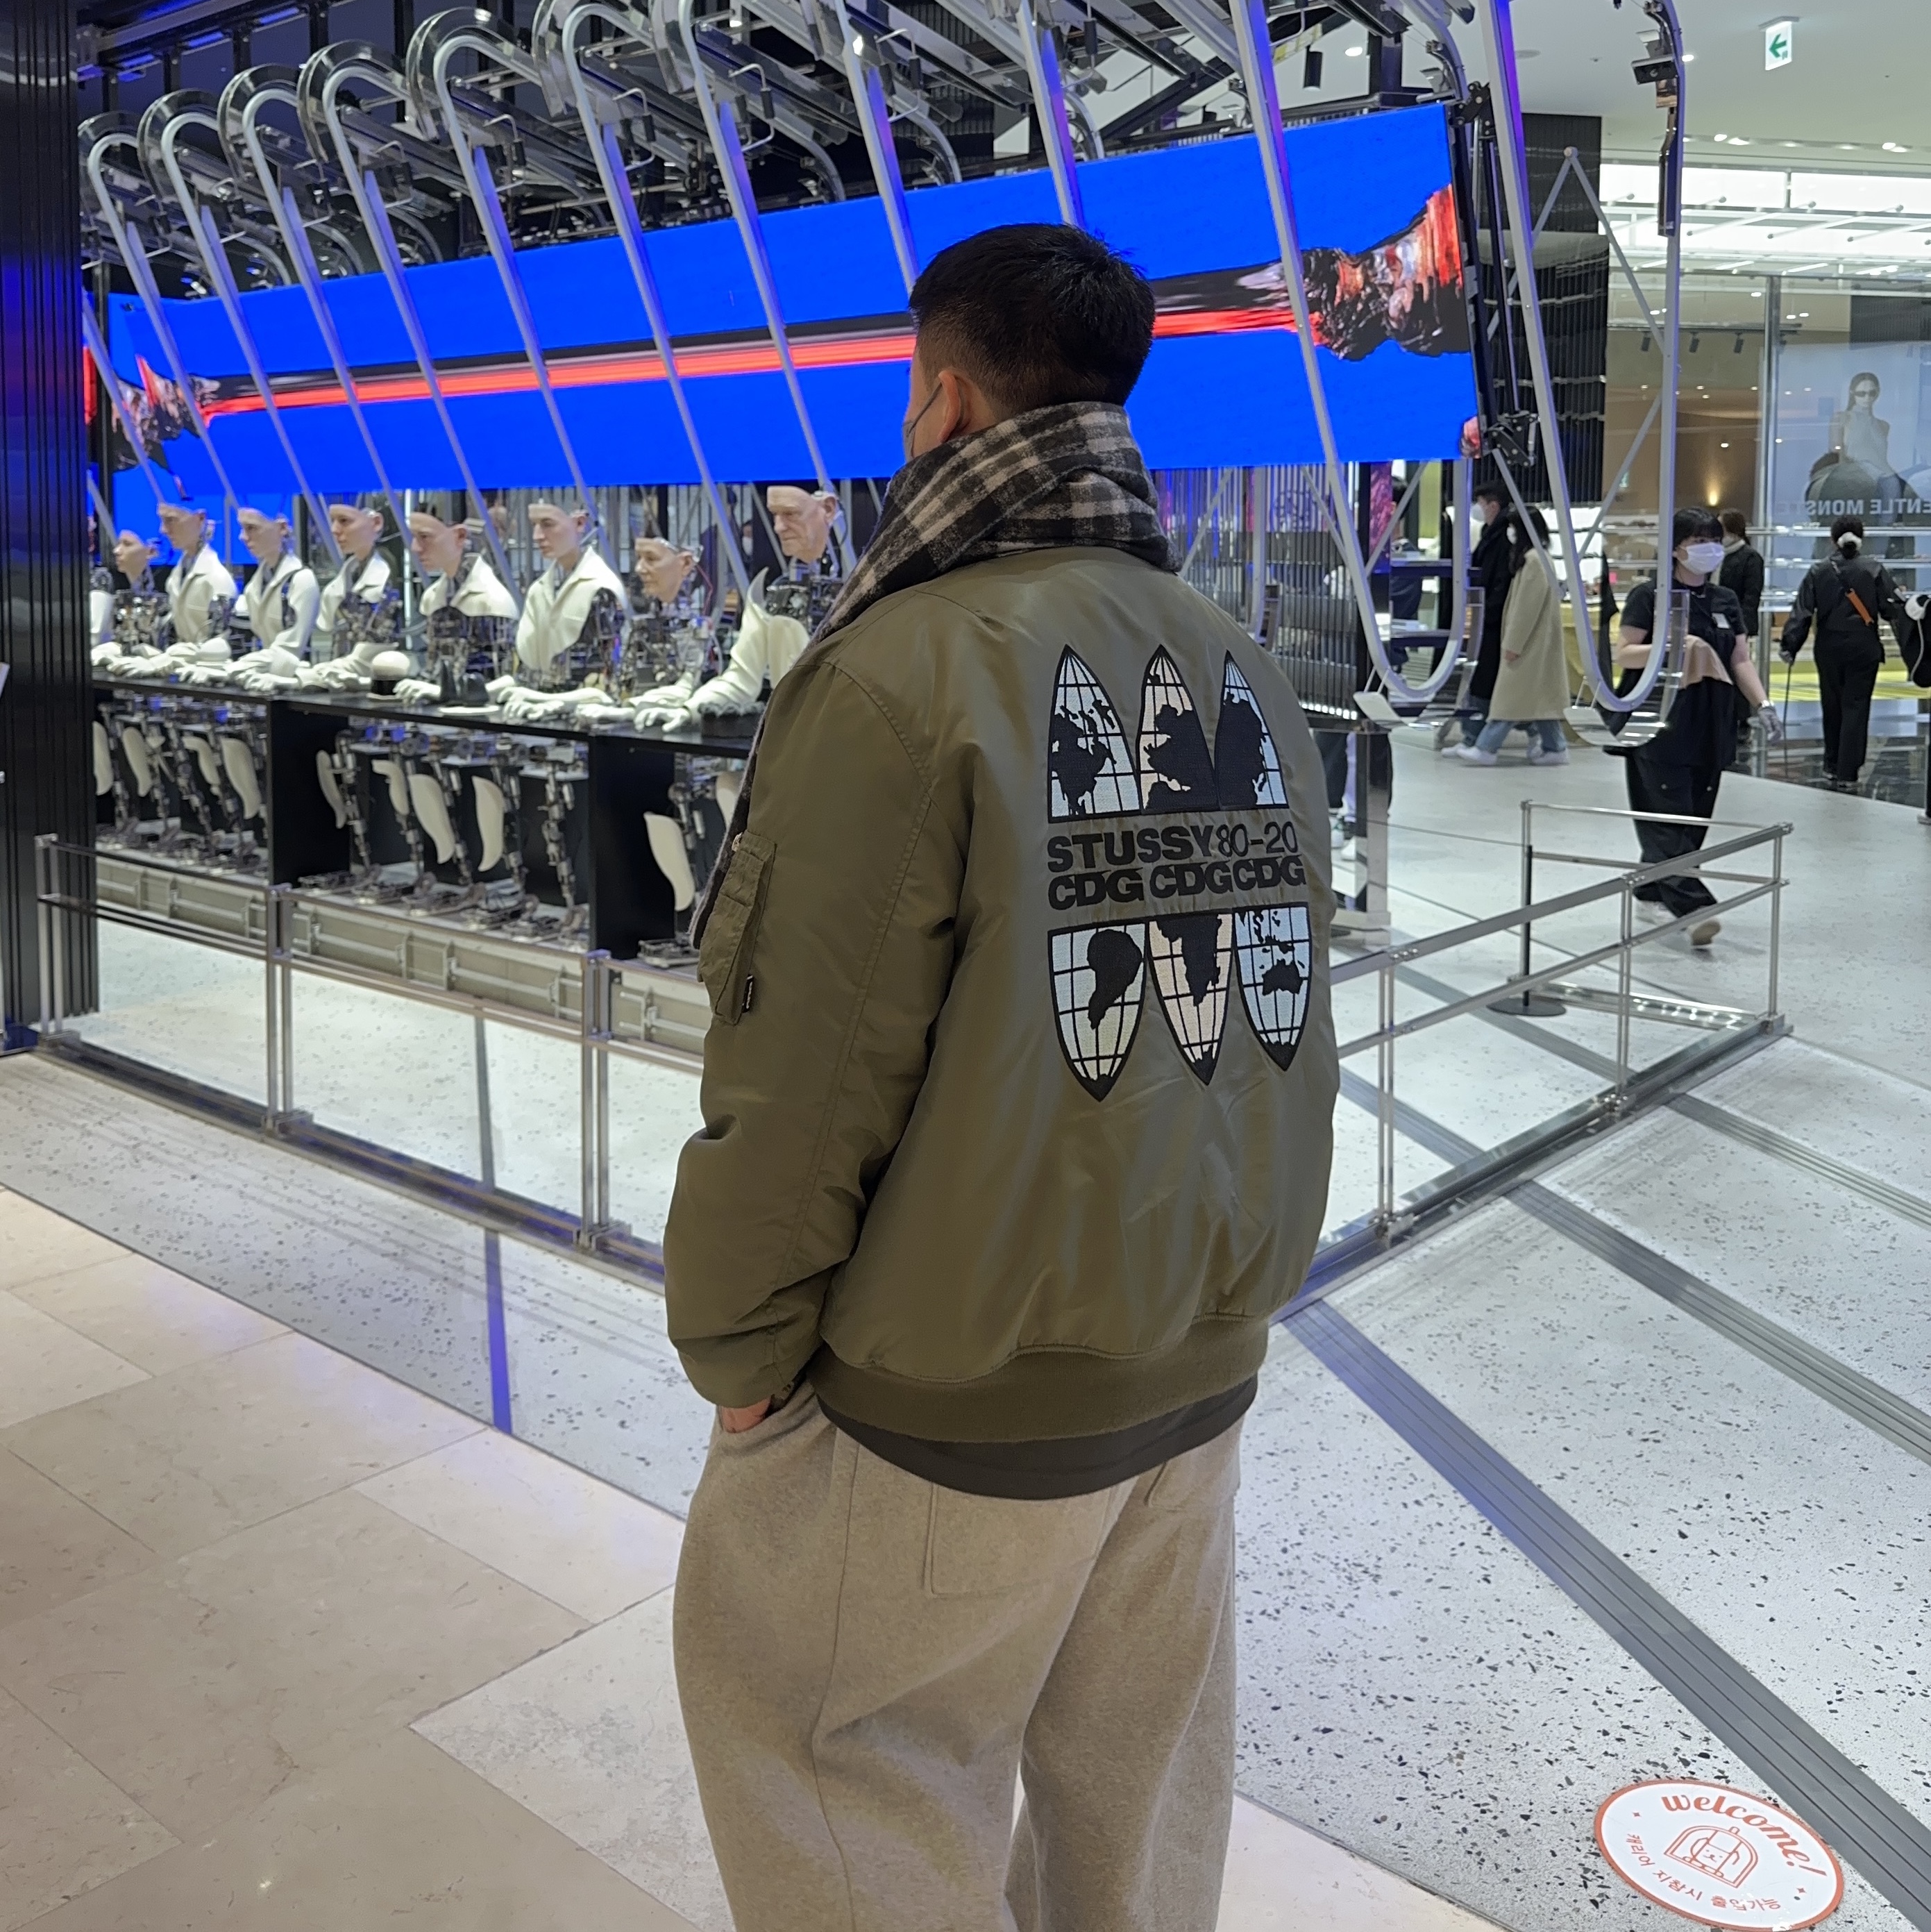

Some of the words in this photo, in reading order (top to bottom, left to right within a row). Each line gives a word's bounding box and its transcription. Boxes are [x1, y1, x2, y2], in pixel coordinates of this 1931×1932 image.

[1047, 824, 1215, 873] STUSSY
[1216, 821, 1299, 857] 80-20
[1048, 866, 1145, 911] CDG
[1661, 1794, 1828, 1876] welcome!
[1626, 1833, 1655, 1866] 캐리어
[1652, 1869, 1703, 1901] 지참시
